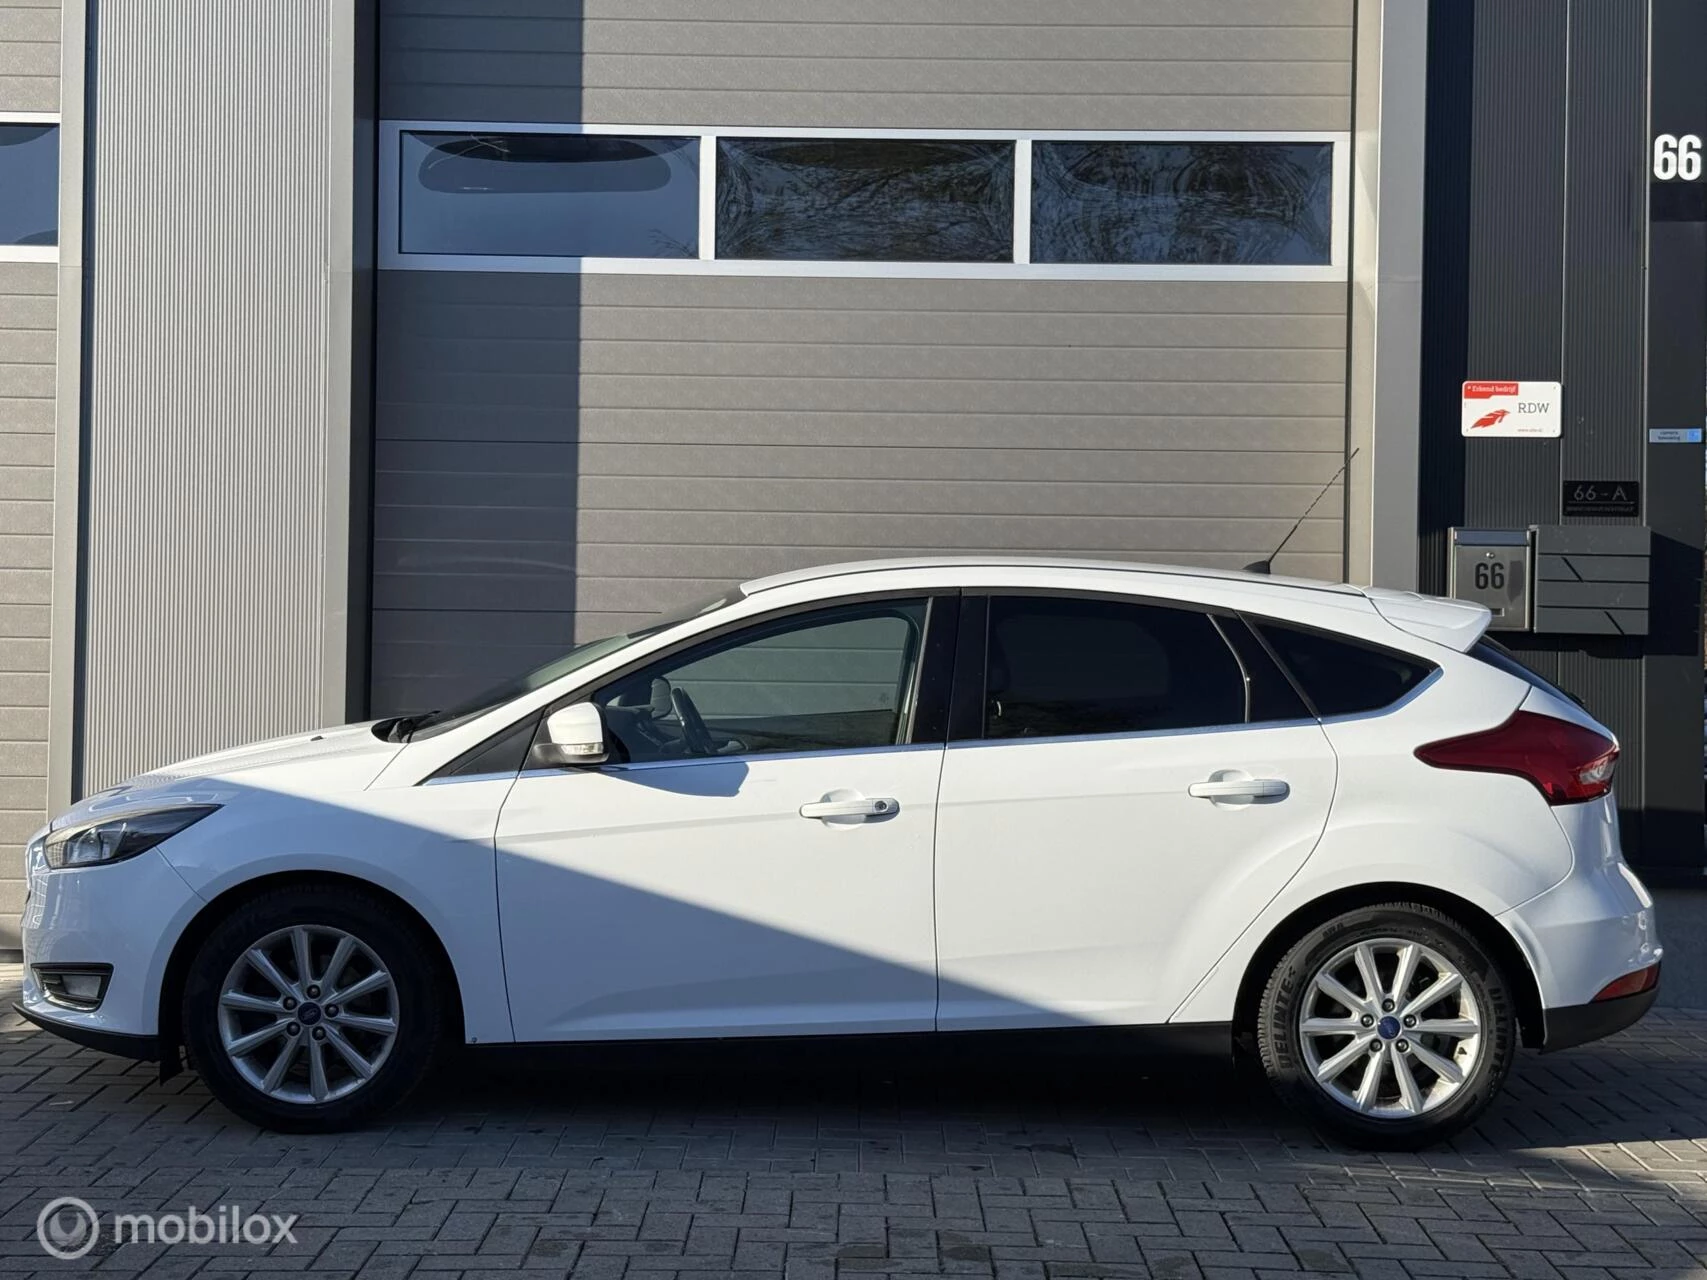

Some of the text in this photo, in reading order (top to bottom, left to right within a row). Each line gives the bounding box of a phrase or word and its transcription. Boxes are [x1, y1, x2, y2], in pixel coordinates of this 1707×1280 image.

[1653, 133, 1702, 180] 66
[1518, 402, 1549, 414] RDW
[1474, 562, 1505, 590] 66
[1274, 979, 1295, 1069] DELINTE
